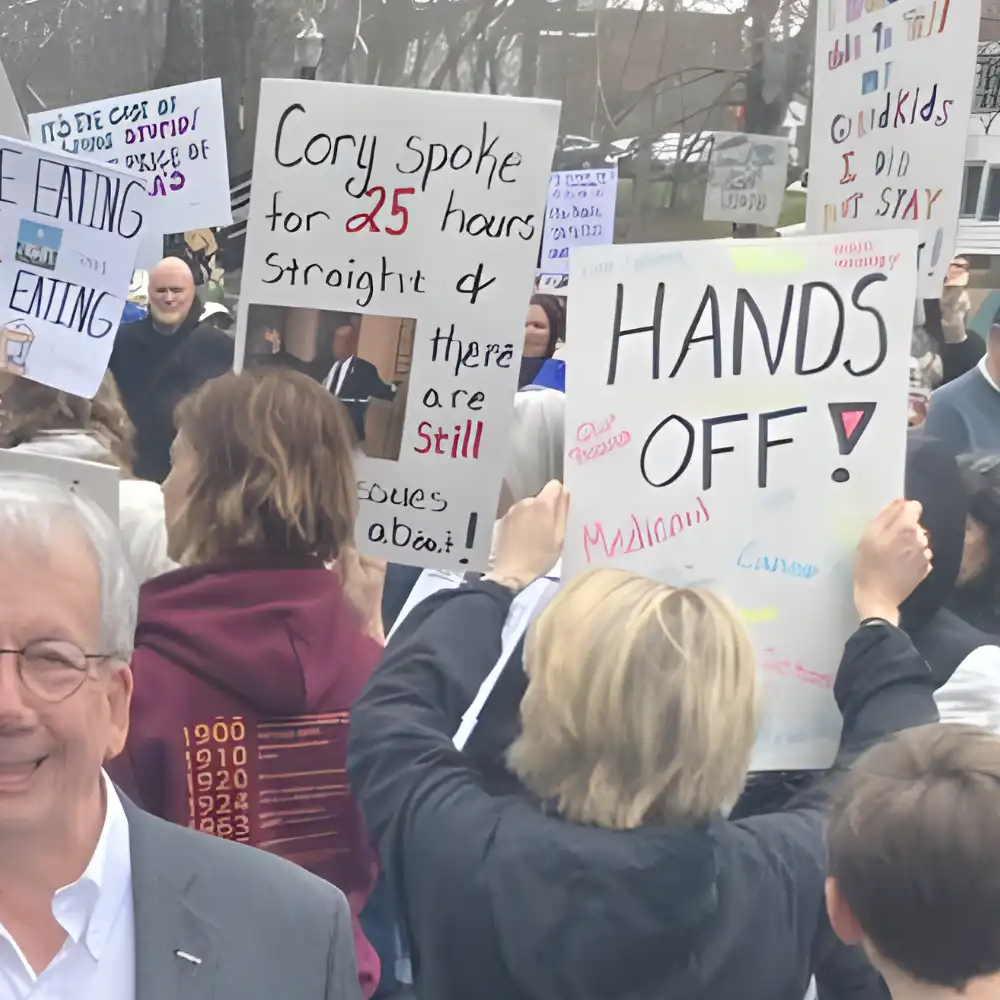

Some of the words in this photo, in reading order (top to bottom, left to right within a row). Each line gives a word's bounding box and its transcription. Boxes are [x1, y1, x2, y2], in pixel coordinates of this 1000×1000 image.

[273, 103, 377, 198] Cory
[33, 157, 148, 239] EATING
[264, 191, 330, 233] for
[346, 186, 415, 235] 25
[440, 191, 536, 241] hours
[9, 269, 118, 339] EATING
[606, 273, 888, 386] HANDS
[429, 324, 515, 376] there
[422, 388, 486, 411] are
[413, 419, 483, 459] Still
[183, 719, 246, 747] 1900
